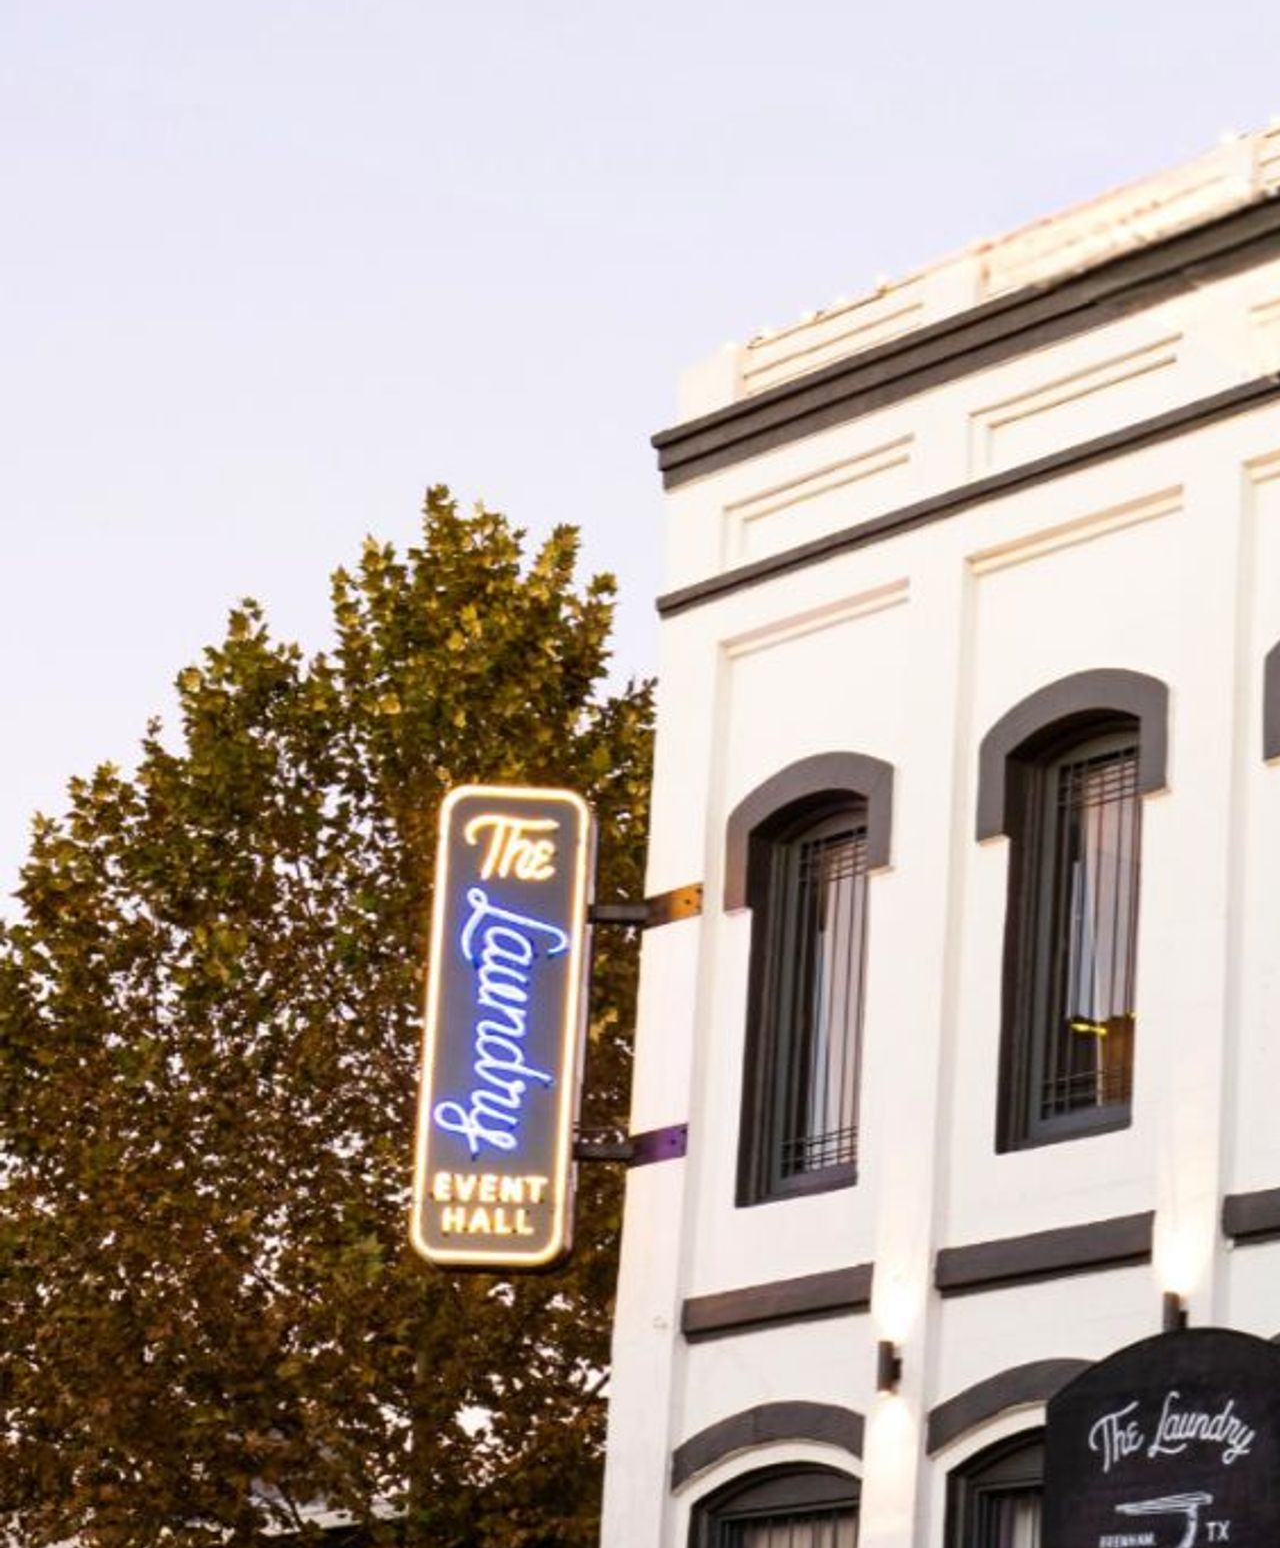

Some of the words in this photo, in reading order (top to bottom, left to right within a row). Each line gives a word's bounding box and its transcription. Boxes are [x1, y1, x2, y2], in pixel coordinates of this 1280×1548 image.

[465, 814, 561, 880] The
[434, 887, 570, 1153] Laundry
[432, 1171, 549, 1205] EVENT
[441, 1207, 534, 1235] HALL
[1088, 1401, 1144, 1473] The
[1147, 1390, 1256, 1465] Laundry
[1206, 1520, 1231, 1541] TX
